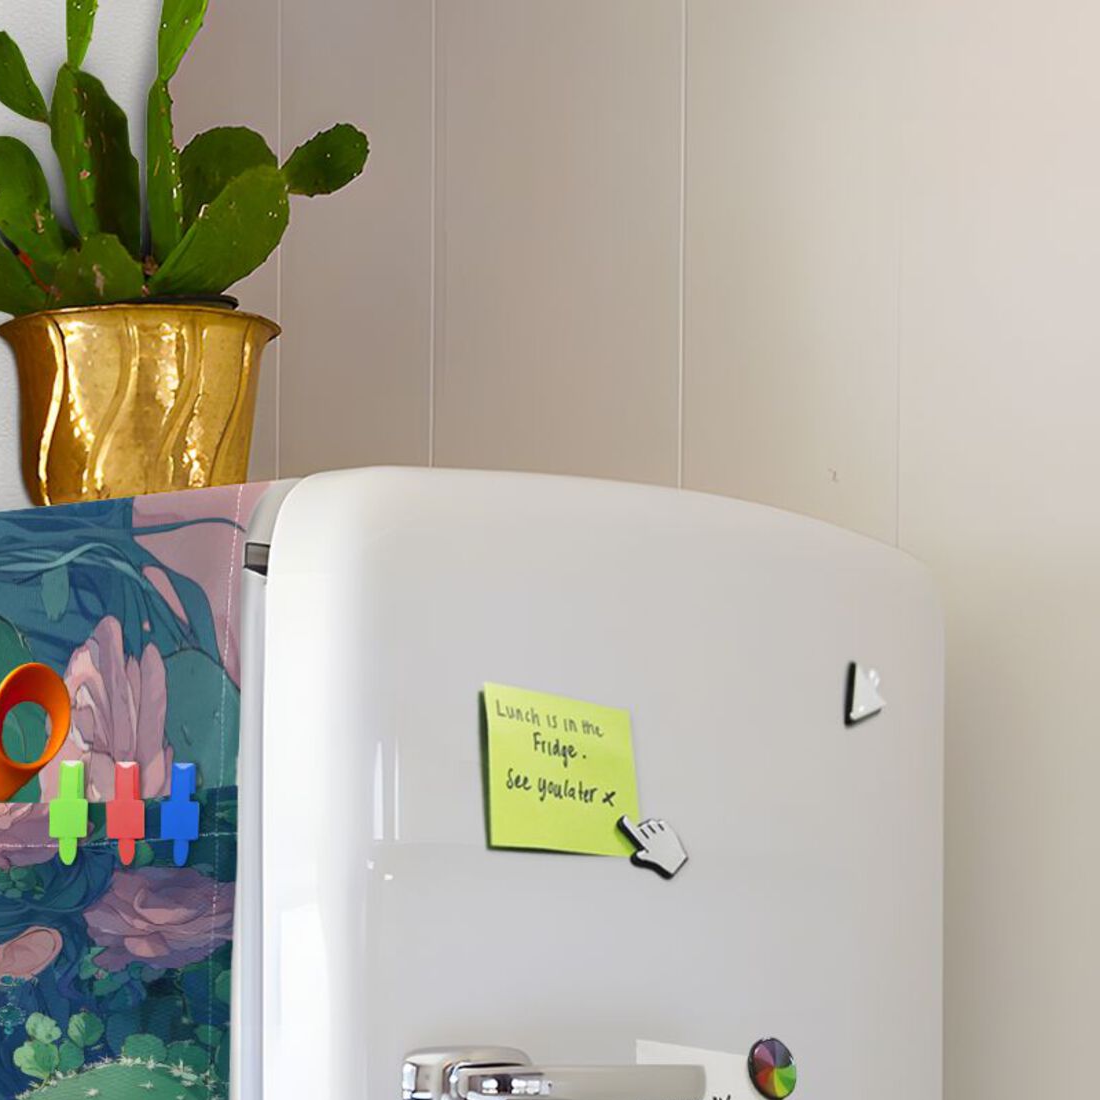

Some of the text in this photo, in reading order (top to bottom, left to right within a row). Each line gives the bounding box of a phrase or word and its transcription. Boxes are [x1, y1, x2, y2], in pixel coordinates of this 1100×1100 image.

[495, 699, 540, 727] Lunch
[582, 719, 604, 738] the
[506, 768, 532, 790] See
